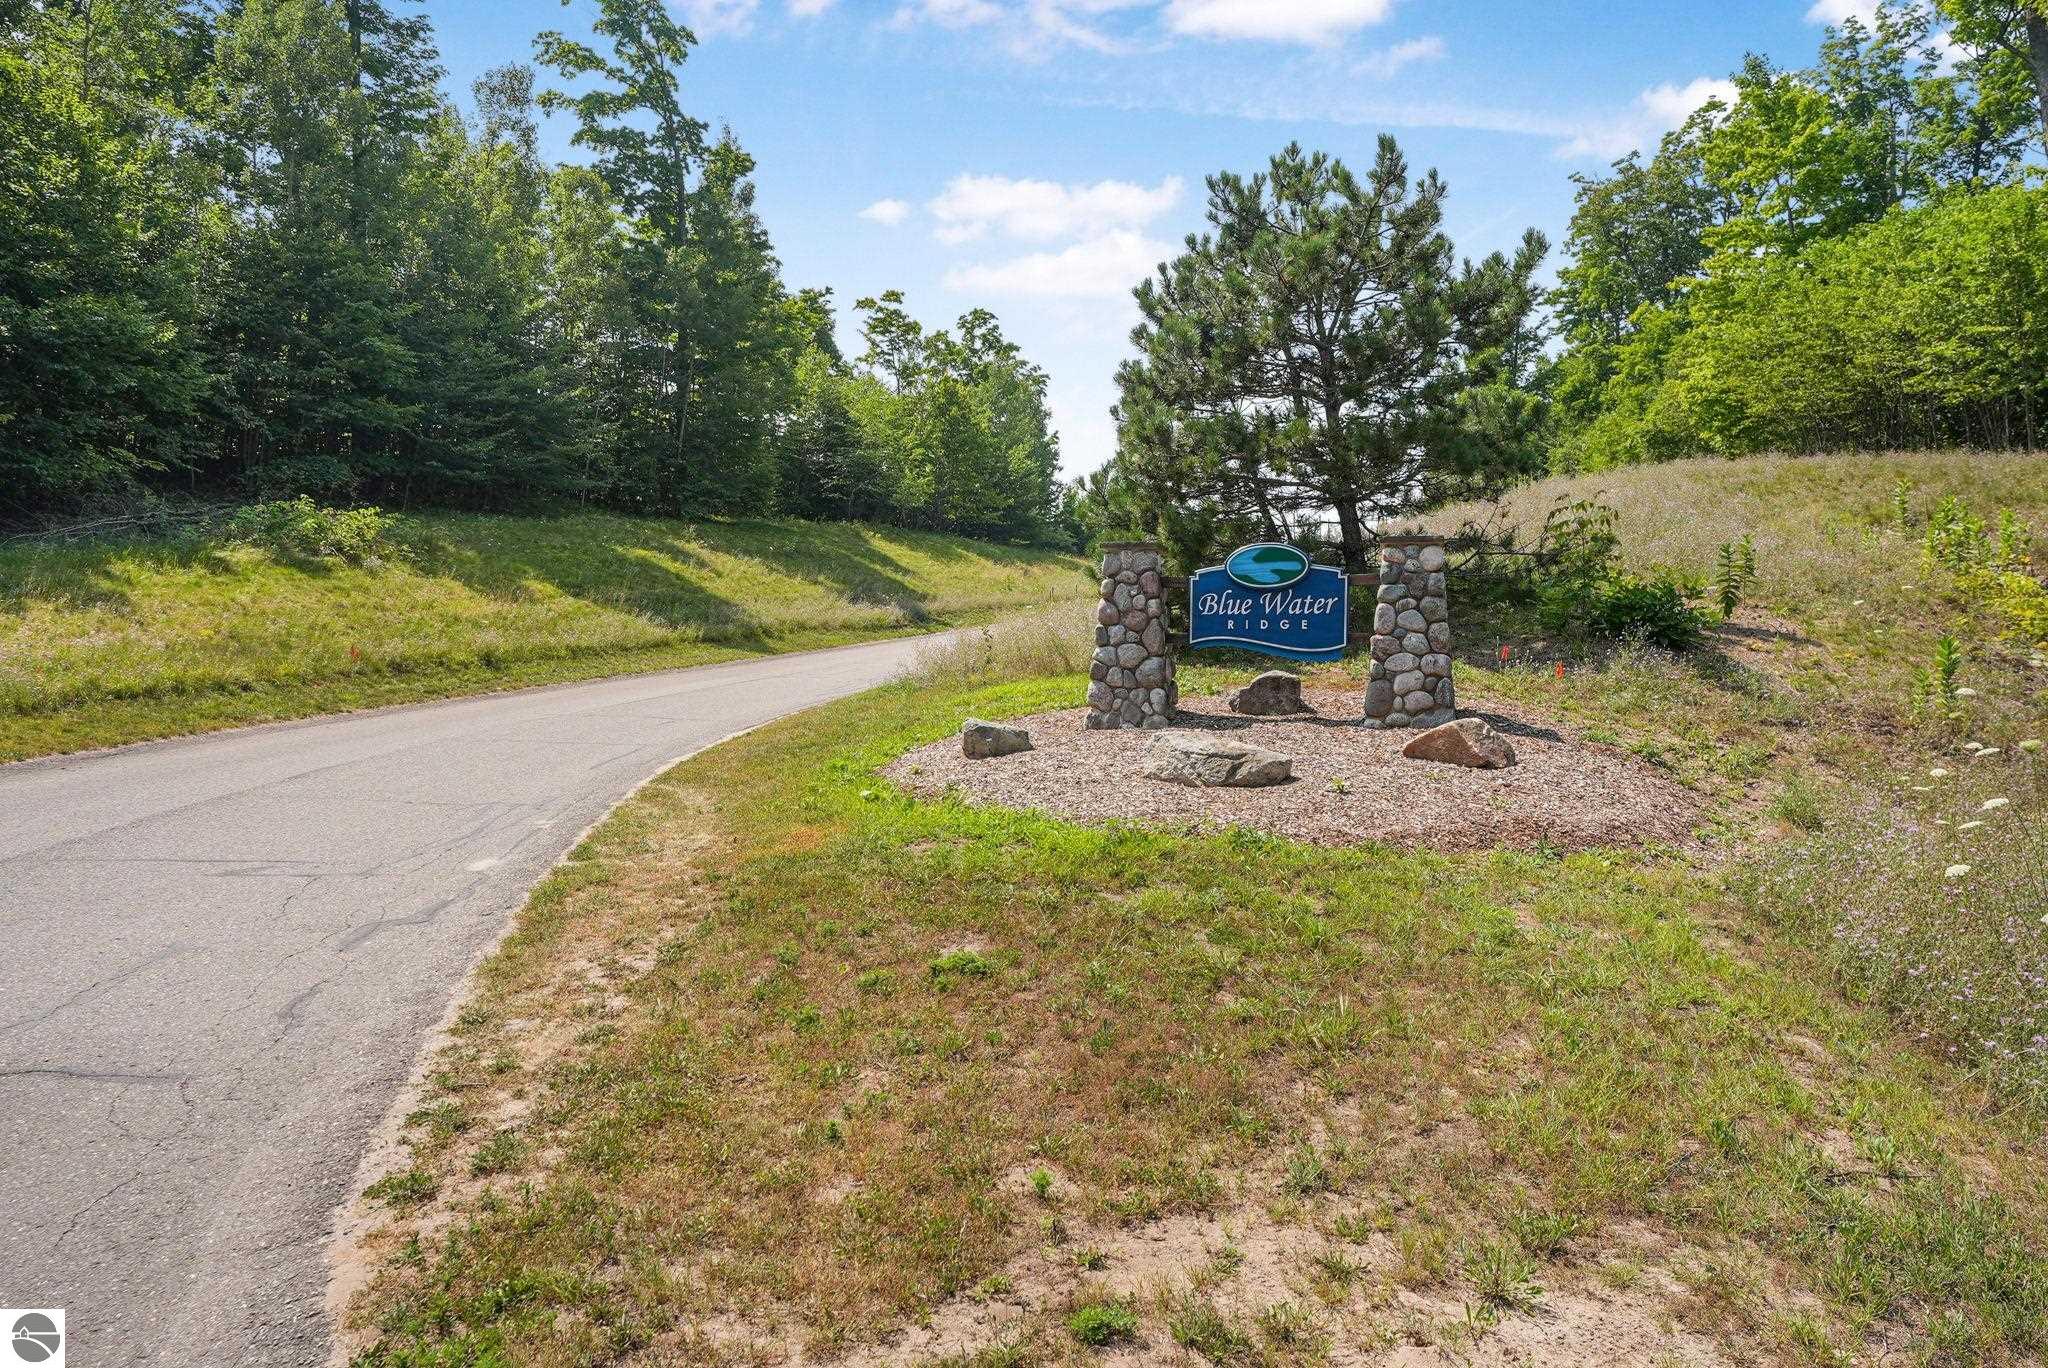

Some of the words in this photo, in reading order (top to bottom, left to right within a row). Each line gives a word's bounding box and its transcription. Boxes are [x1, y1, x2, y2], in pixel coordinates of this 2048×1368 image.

[1198, 589, 1252, 615] Blue
[1260, 589, 1338, 615] Water
[1227, 619, 1308, 630] RIDGE
